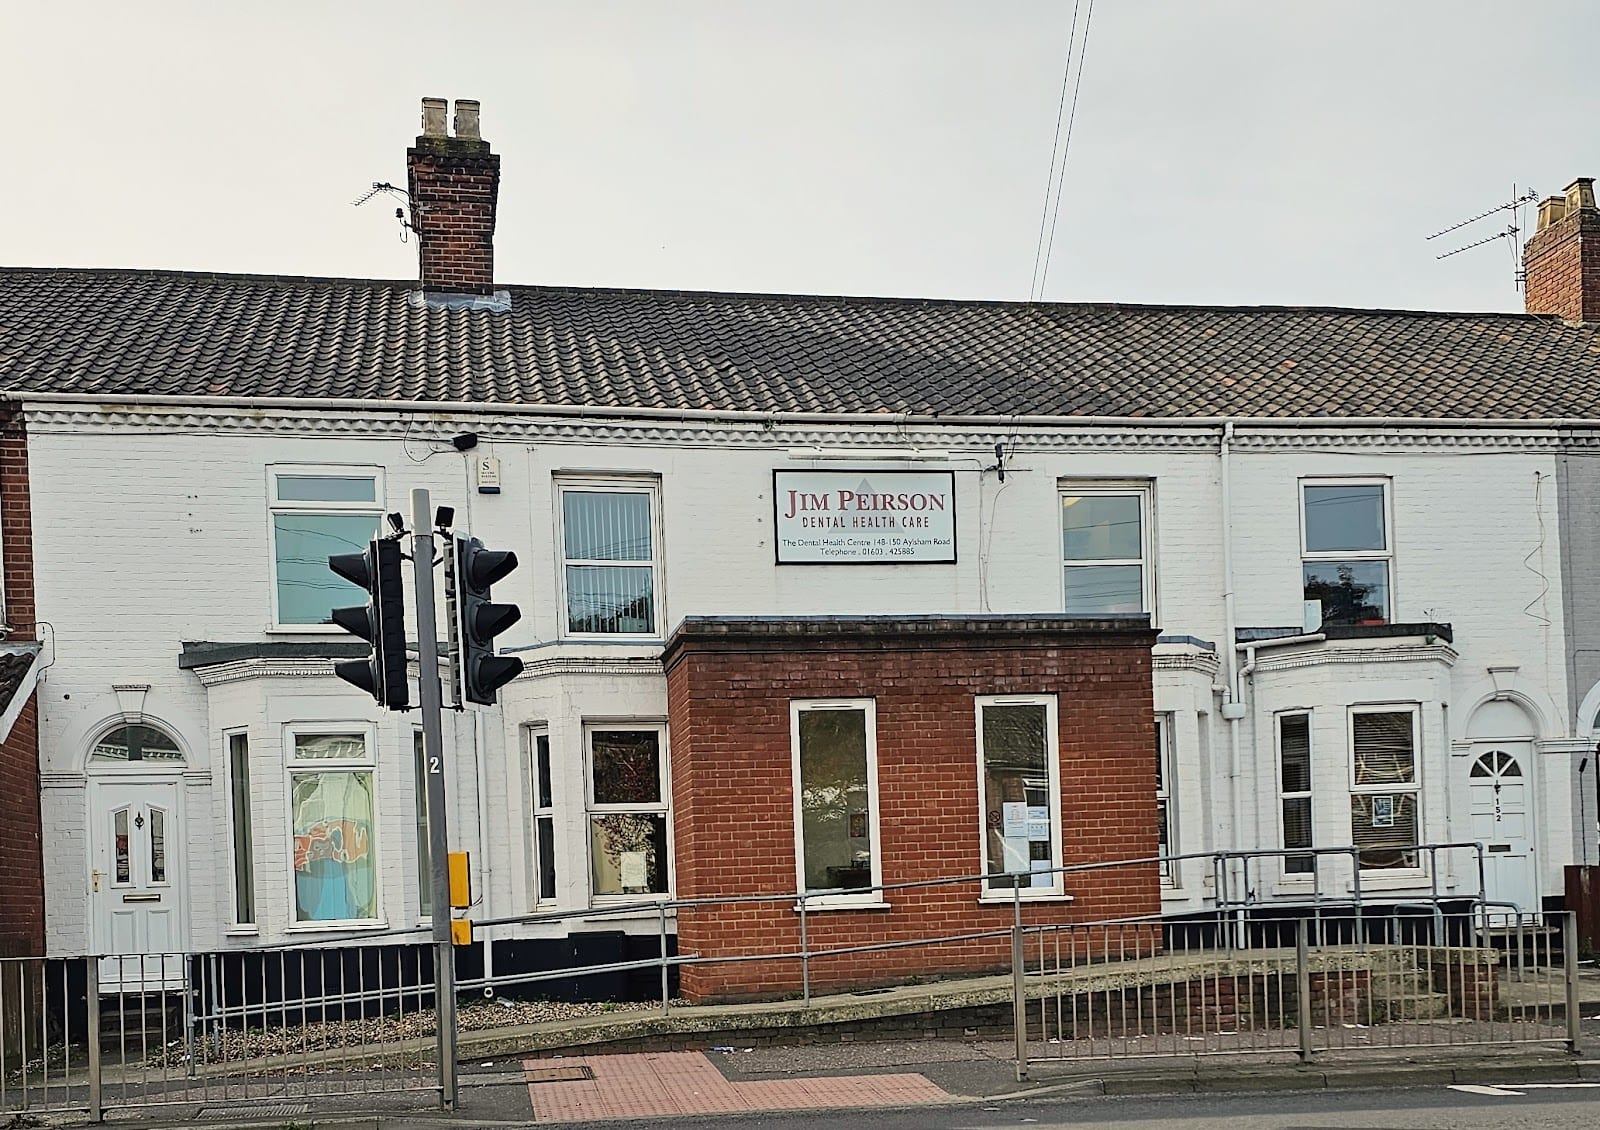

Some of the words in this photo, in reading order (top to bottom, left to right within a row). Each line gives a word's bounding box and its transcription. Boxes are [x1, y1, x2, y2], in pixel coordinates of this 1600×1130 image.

[785, 490, 830, 518] JIM
[837, 490, 946, 511] PEIRSON
[802, 516, 846, 528] DENTAL
[852, 516, 895, 528] HEALTH
[902, 516, 930, 528] CARE
[820, 548, 856, 557] Telephone
[430, 756, 440, 774] 2
